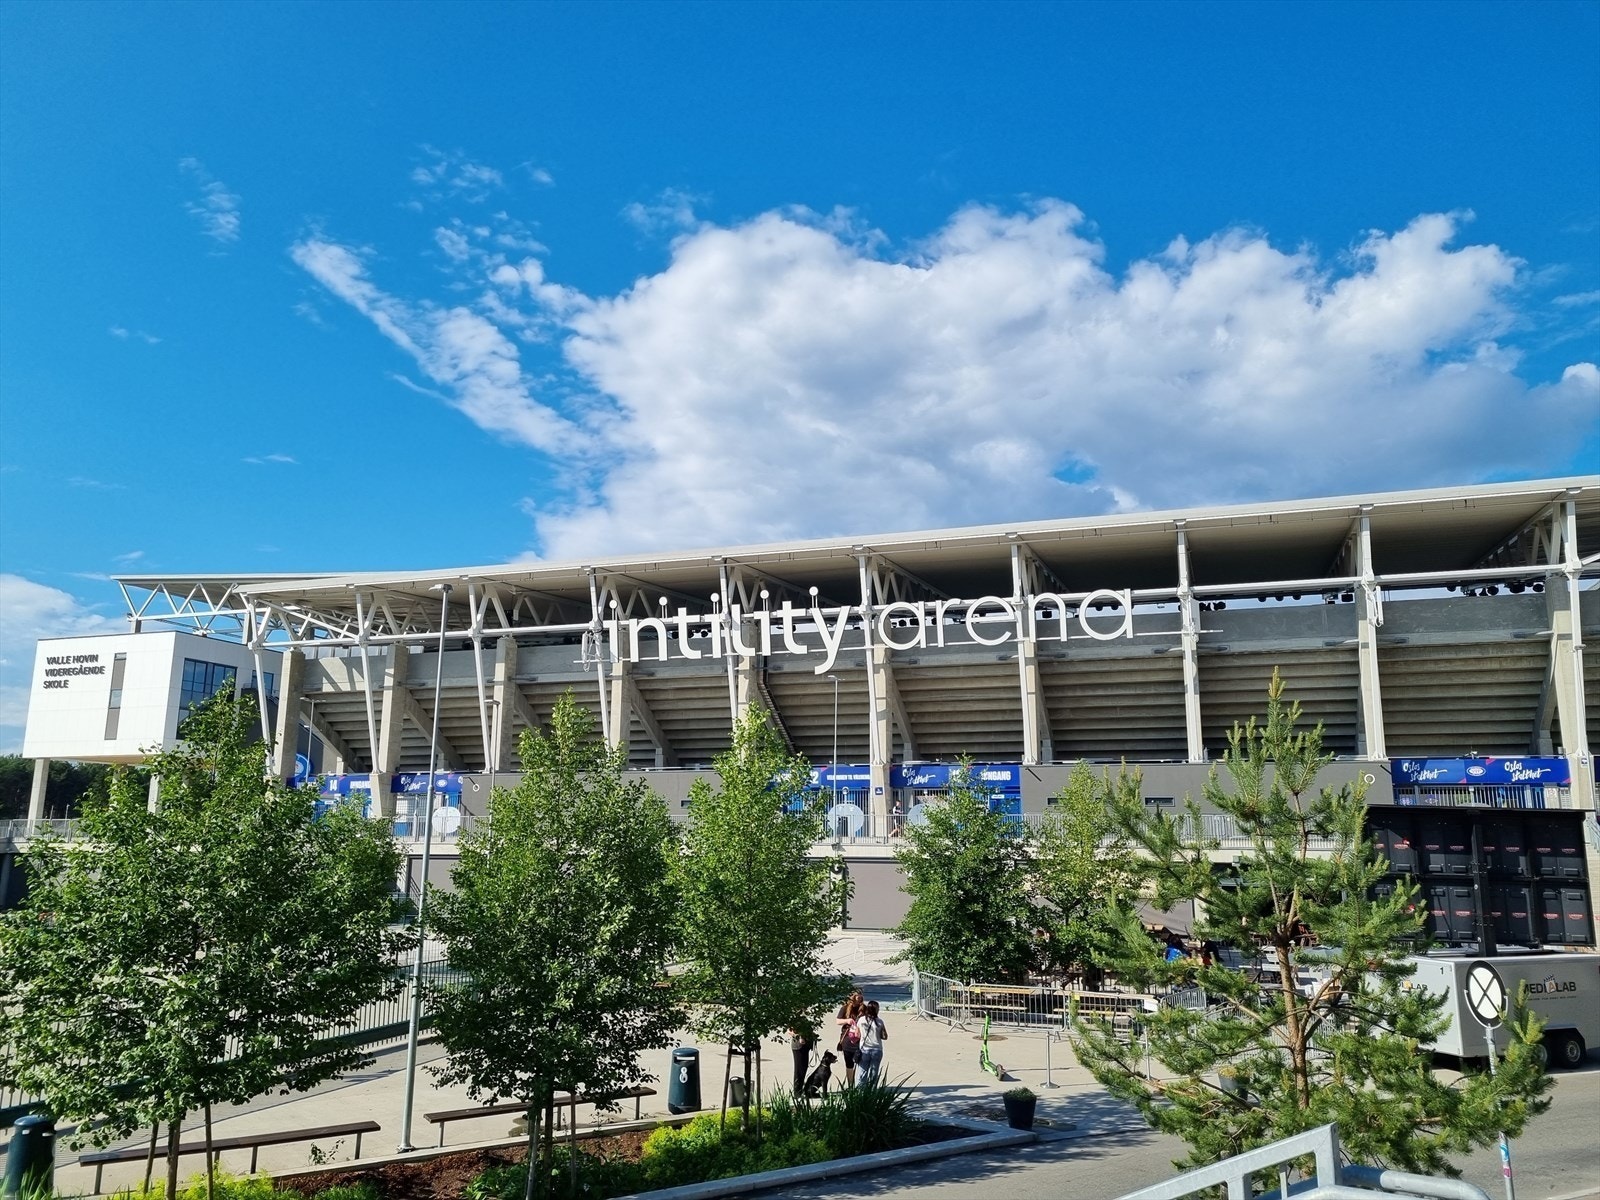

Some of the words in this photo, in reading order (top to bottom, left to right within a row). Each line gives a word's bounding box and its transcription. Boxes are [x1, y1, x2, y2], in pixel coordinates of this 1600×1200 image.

[608, 586, 851, 676] intility
[878, 587, 1134, 651] arena
[46, 656, 71, 665] VALLE
[72, 654, 98, 664] HOVIN
[45, 665, 106, 677] VIDEREGÅENDE
[43, 680, 70, 689] SKOLE
[1504, 760, 1523, 773] Oslos
